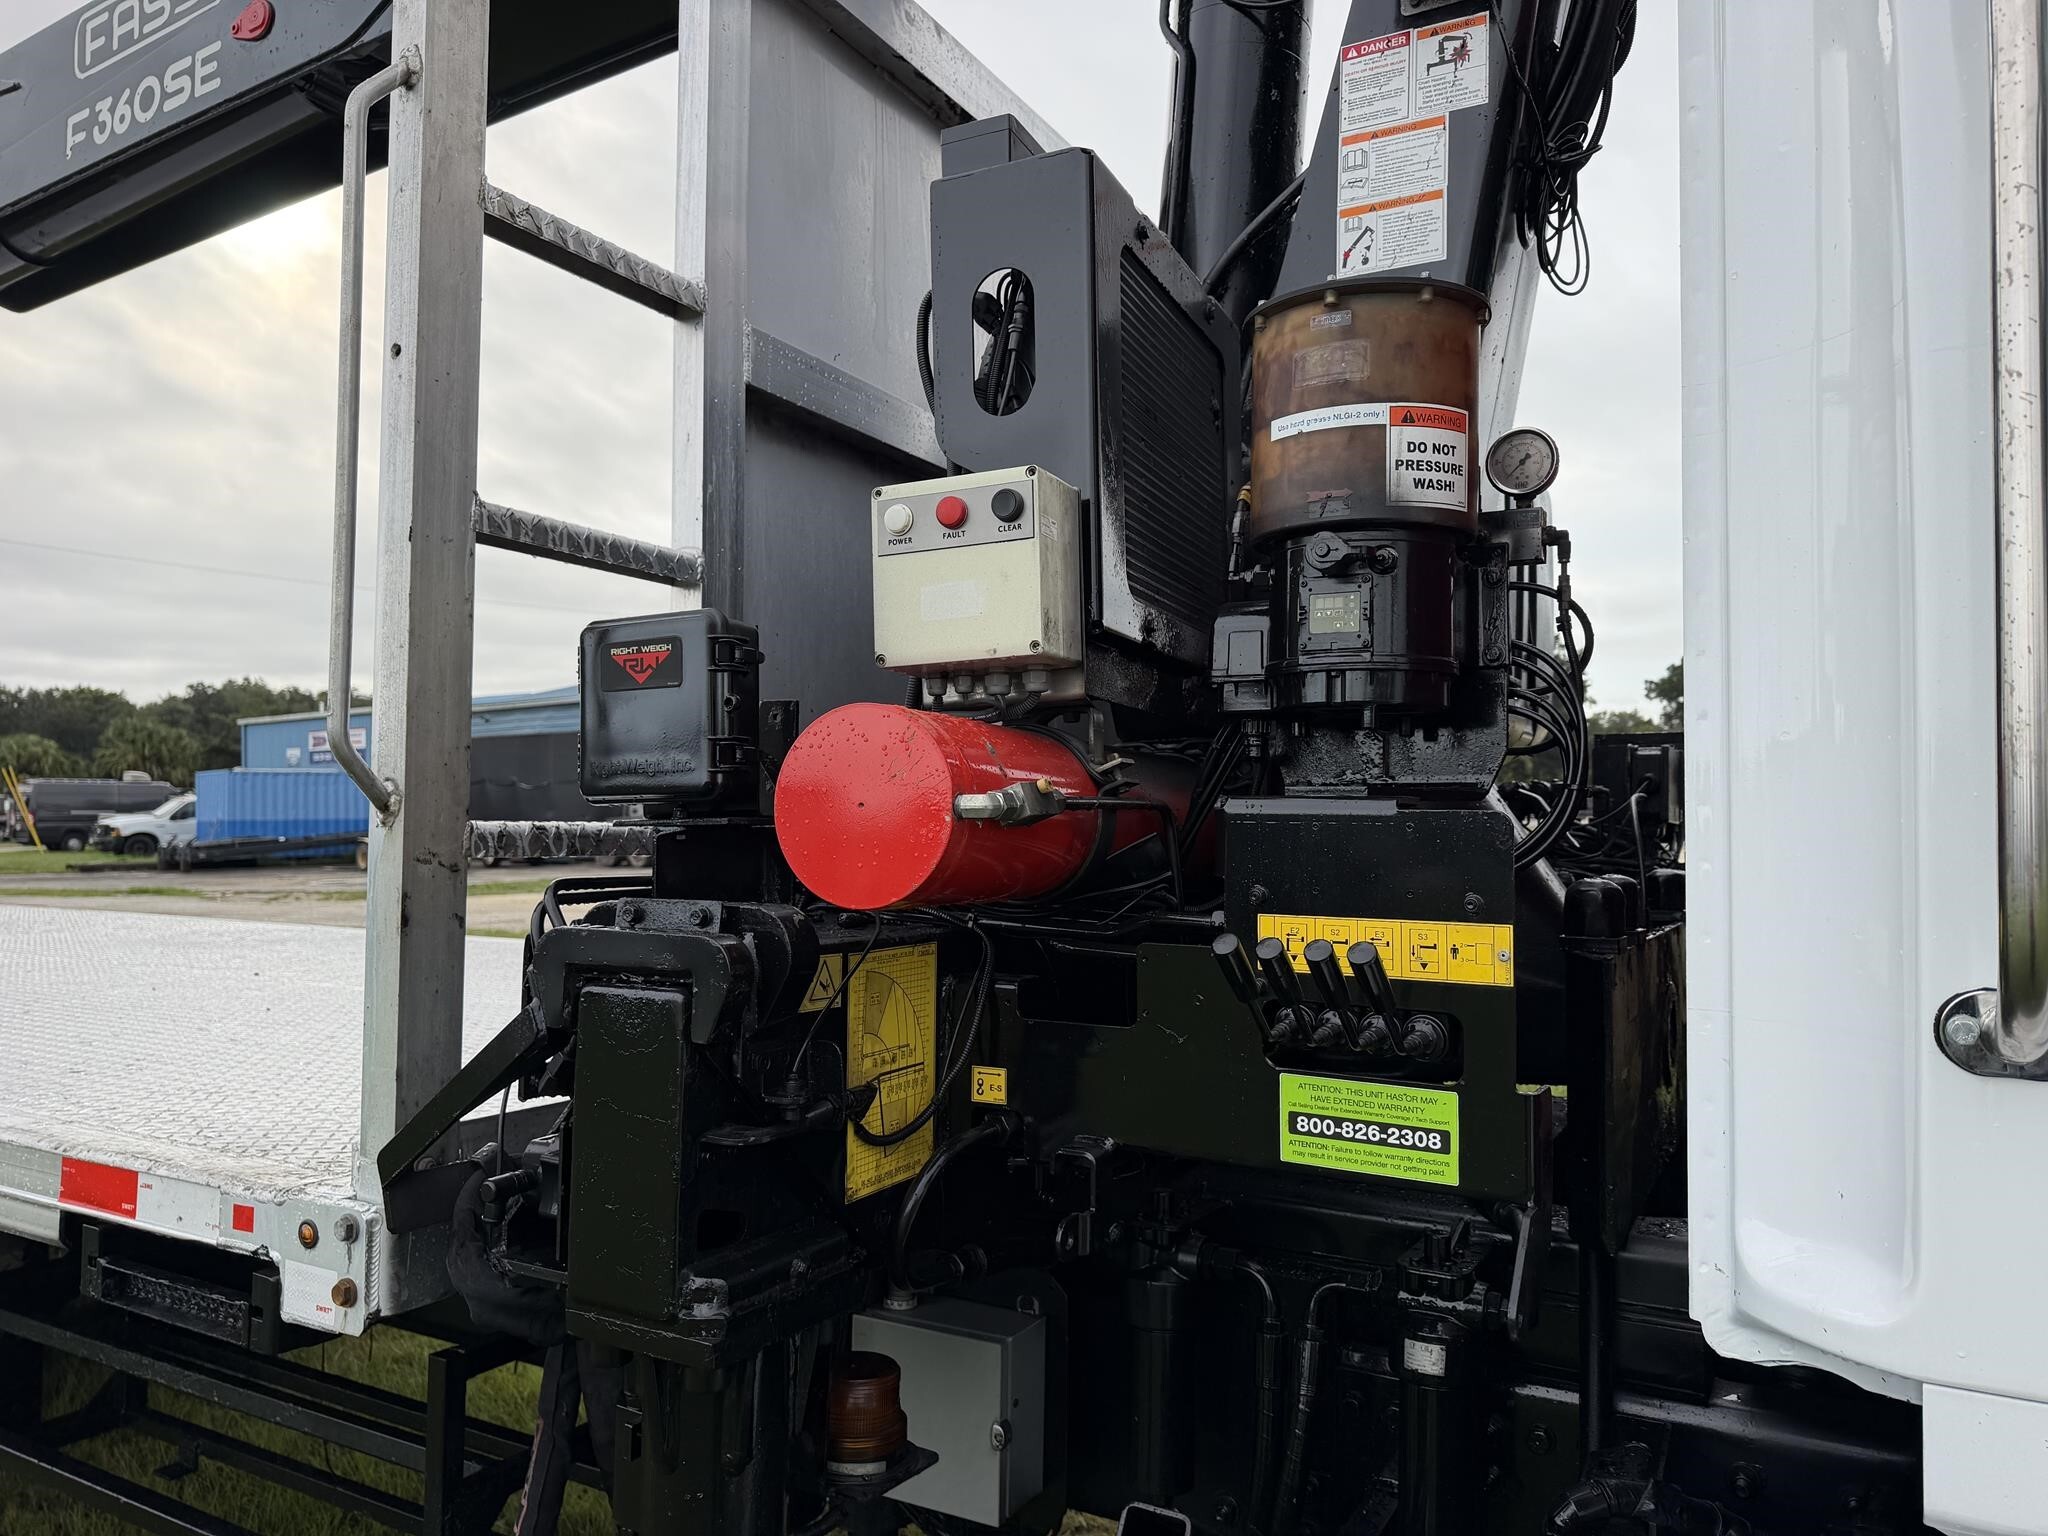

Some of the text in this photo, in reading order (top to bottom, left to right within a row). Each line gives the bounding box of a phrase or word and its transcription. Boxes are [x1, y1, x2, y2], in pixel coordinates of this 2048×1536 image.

[1439, 19, 1476, 33] WARNING
[1361, 36, 1406, 54] DANGER
[66, 40, 222, 160] F360SE
[1380, 124, 1417, 137] WARNING
[1378, 197, 1415, 209] WARNING
[1363, 410, 1381, 420] only
[1416, 413, 1461, 428] WARNING
[1407, 441, 1457, 457] DO NOT
[1395, 459, 1464, 476] PRESSURE
[1413, 477, 1455, 493] WASH!
[943, 530, 966, 539] FAULT
[998, 523, 1022, 533] CLEAR
[888, 537, 913, 546] POWER
[610, 643, 672, 655] RIGHT WEIGH
[1290, 927, 1300, 935] E2
[1330, 928, 1340, 936] S2
[1418, 933, 1429, 941] S3
[1297, 1083, 1438, 1105] ATTENTION: THIS UNIT HAS OR MAY
[1310, 1095, 1425, 1115] HAVE EXTENDED WARRANTY
[1340, 1107, 1362, 1115] Extended
[1364, 1110, 1385, 1119] Warranty
[1387, 1113, 1410, 1122] Coverage
[1428, 1118, 1450, 1126] Support
[1296, 1116, 1442, 1150] 800-826-2308
[1289, 1139, 1450, 1167] ATTENTION: Failure to follow warranty directions
[1292, 1150, 1306, 1159] may
[1308, 1151, 1325, 1160] result
[1334, 1156, 1358, 1165] service
[1361, 1159, 1388, 1170] provider
[1390, 1162, 1401, 1171] not
[1403, 1164, 1427, 1176] getting
[1429, 1167, 1446, 1177] paid.
